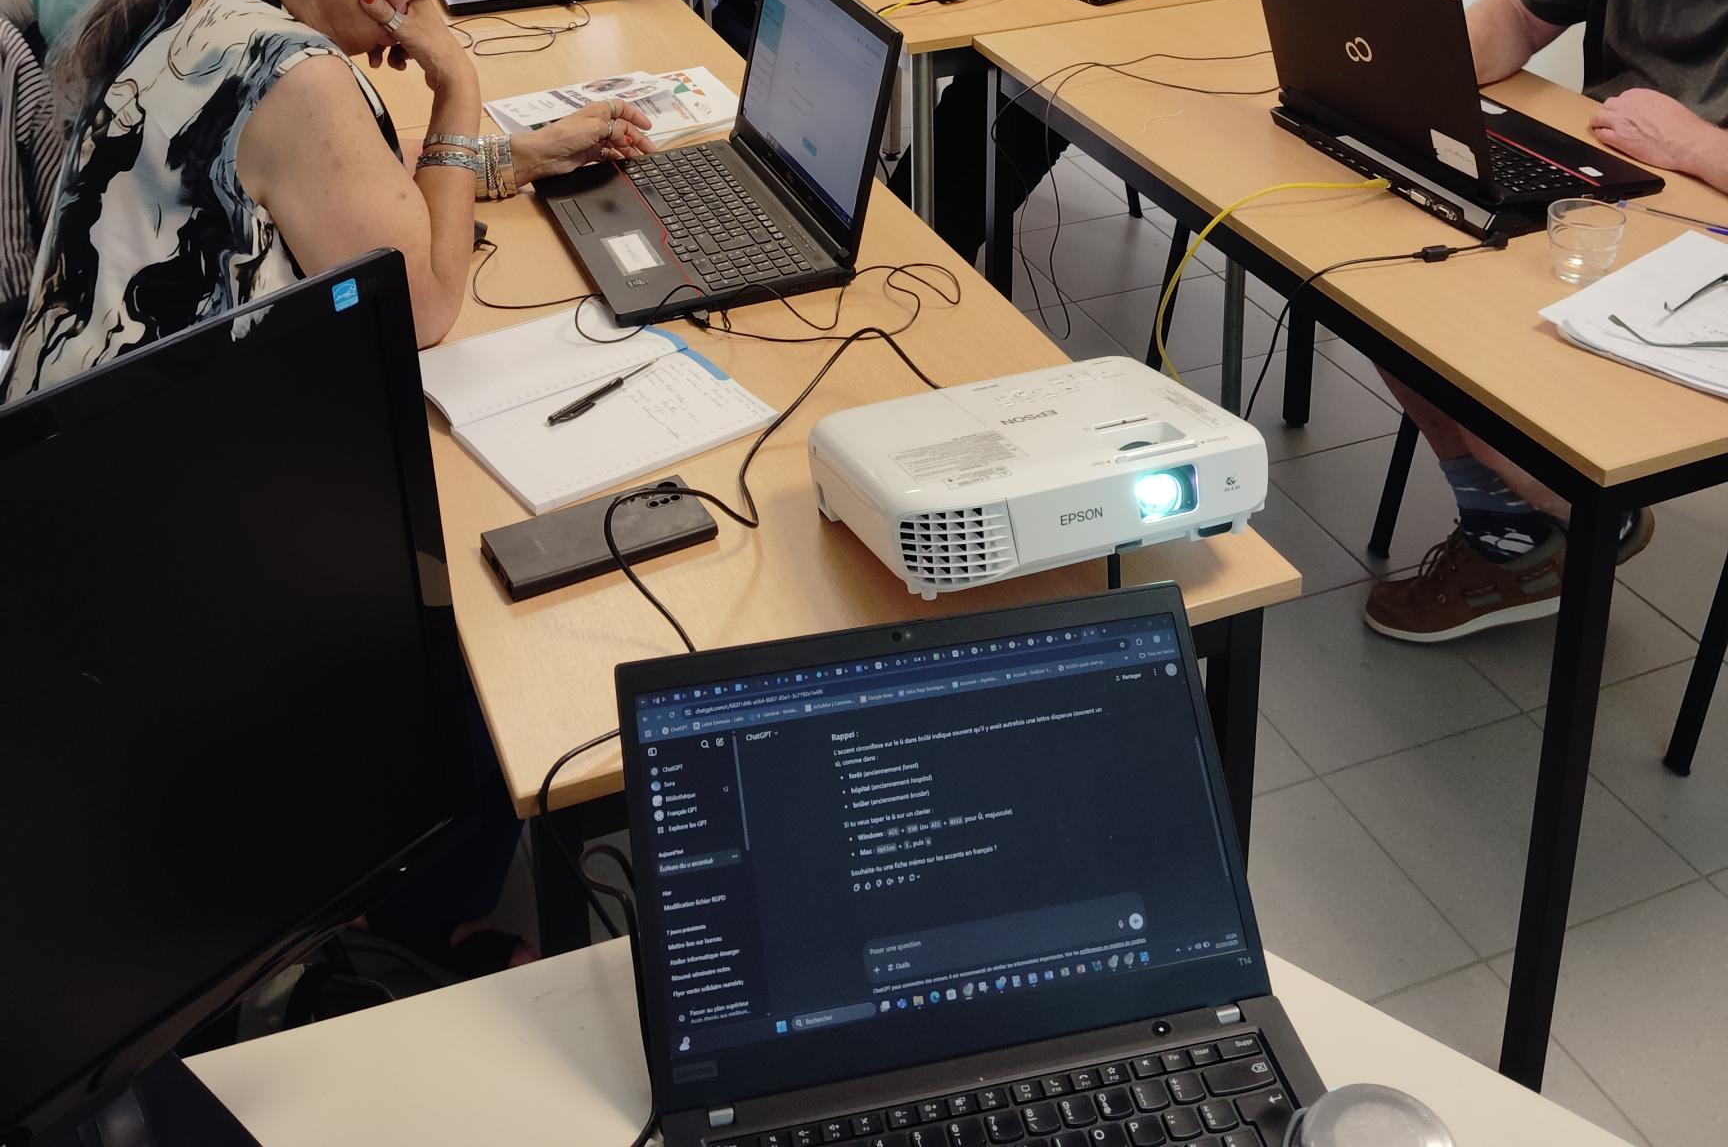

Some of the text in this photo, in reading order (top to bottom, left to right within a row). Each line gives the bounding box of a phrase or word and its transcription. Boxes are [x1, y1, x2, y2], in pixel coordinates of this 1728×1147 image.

[1000, 408, 1059, 426] EPSON
[1060, 506, 1104, 527] EPSON
[745, 730, 772, 741] ChatGPT
[831, 730, 855, 743] Rappel
[833, 746, 855, 756] L'accent
[904, 736, 917, 744] dans
[931, 730, 951, 740] indique
[951, 727, 972, 736] souvent
[973, 725, 984, 734] qu'il
[1002, 719, 1025, 728] autrefois
[1050, 711, 1072, 721] disparue
[842, 757, 862, 766] comme
[862, 754, 876, 762] dans
[662, 763, 683, 772] ChatGPT
[870, 815, 884, 825] taper
[913, 807, 930, 816] clavier
[857, 830, 883, 840] Windows
[964, 815, 977, 823] pour
[859, 848, 872, 856] Mac
[894, 860, 907, 869] fiche
[908, 857, 925, 866] mémo
[944, 851, 964, 860] accents
[972, 845, 993, 856] français
[869, 946, 884, 955] Poser
[896, 939, 922, 951] question
[895, 960, 910, 970] Outils
[1026, 1109, 1034, 1117] 8
[951, 1124, 959, 1133] 6
[1130, 1123, 1139, 1133] P
[1094, 1130, 1105, 1140] O
